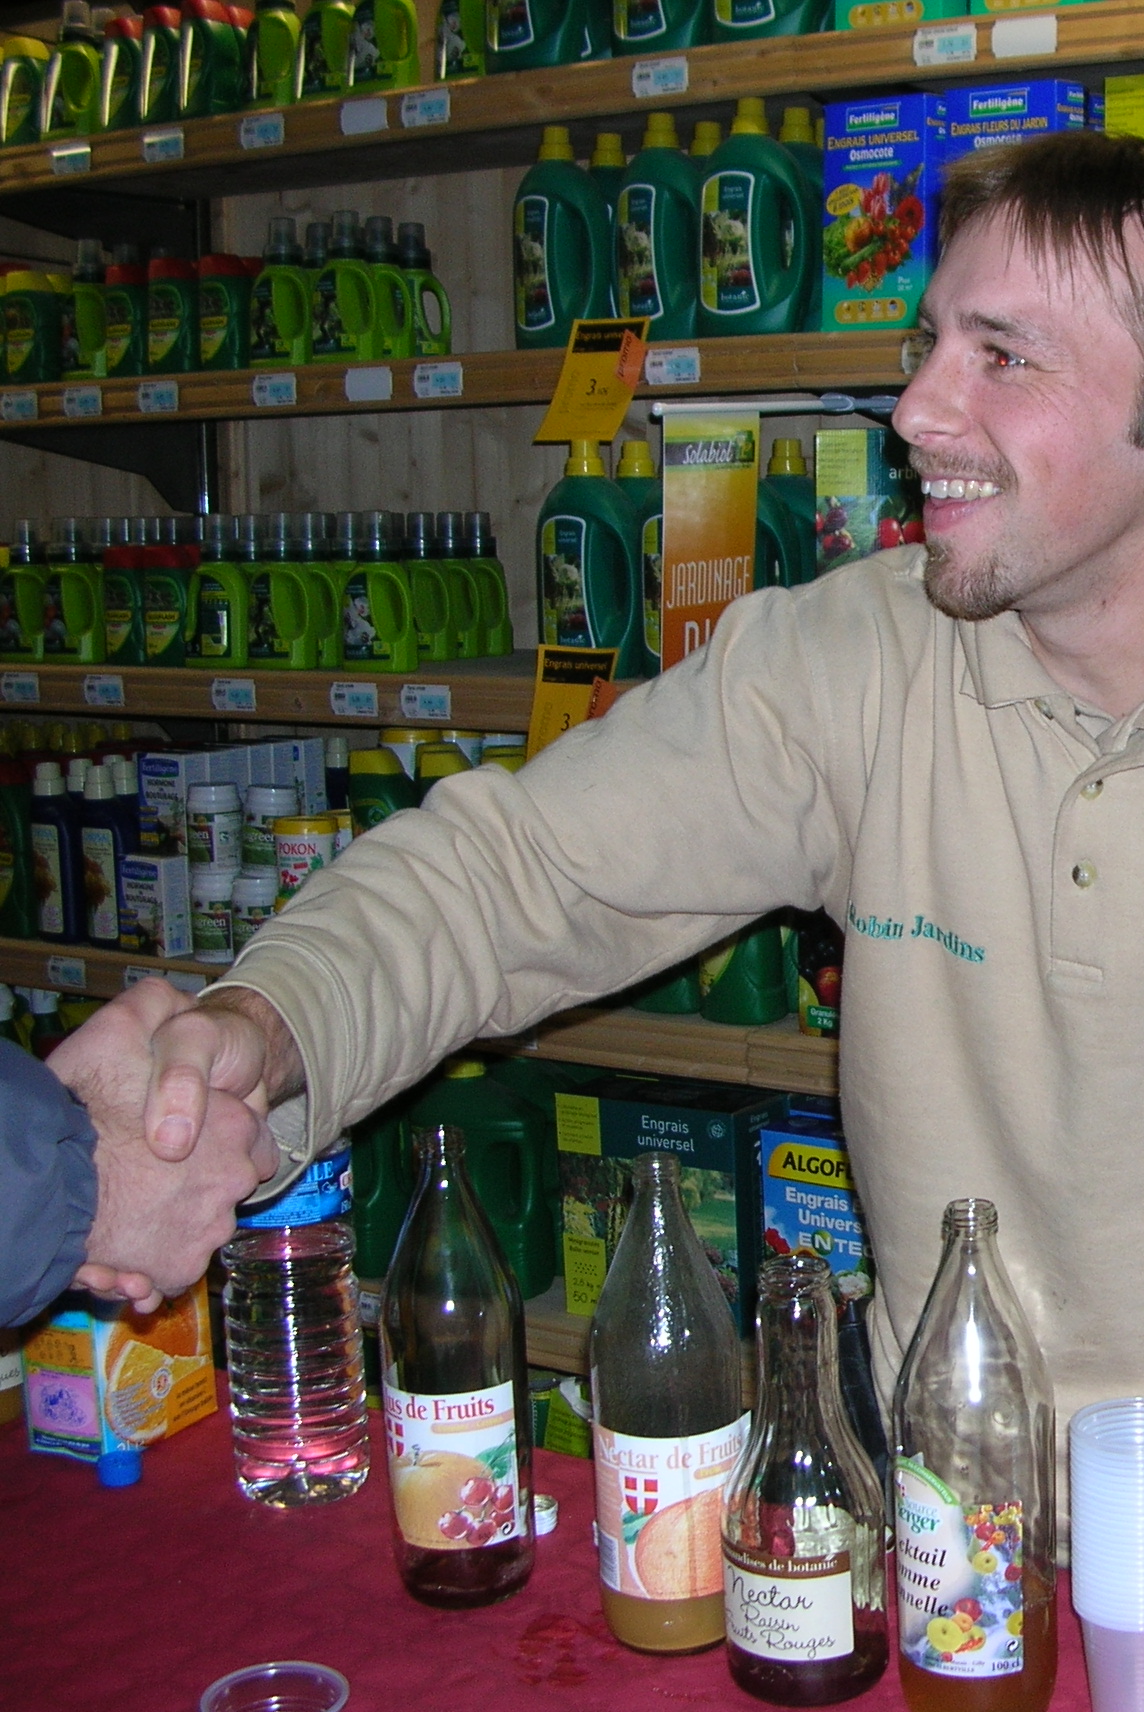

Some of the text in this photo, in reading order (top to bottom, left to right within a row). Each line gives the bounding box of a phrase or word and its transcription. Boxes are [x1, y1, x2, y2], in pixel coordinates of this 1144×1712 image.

[972, 97, 1024, 112] Fertiligène
[848, 111, 896, 126] Fertiligène
[951, 116, 1048, 136] ENGRAIS FLEURS DU JARDIN
[826, 130, 920, 150] ENGRAIS UNIVERSEL
[850, 146, 895, 160] Osmocote
[683, 440, 735, 465] Solabiol
[666, 555, 751, 609] JARDINAGE
[278, 842, 317, 856] POKON
[910, 914, 986, 964] Jardins
[640, 1114, 690, 1134] Engrais
[637, 1134, 695, 1153] universel
[785, 1186, 850, 1212] Engrais
[798, 1208, 863, 1234] Univers
[572, 1290, 589, 1304] 50
[405, 1395, 495, 1420] de Fruits
[666, 1446, 692, 1470] de
[698, 1432, 743, 1465] Fruits
[898, 1505, 940, 1534] erger
[768, 1555, 838, 1573] de botanic
[899, 1538, 947, 1569] cktail
[727, 1565, 814, 1610] Nectar
[740, 1602, 801, 1632] Raisin
[760, 1628, 836, 1660] Rouges
[991, 1661, 1010, 1672] 100
